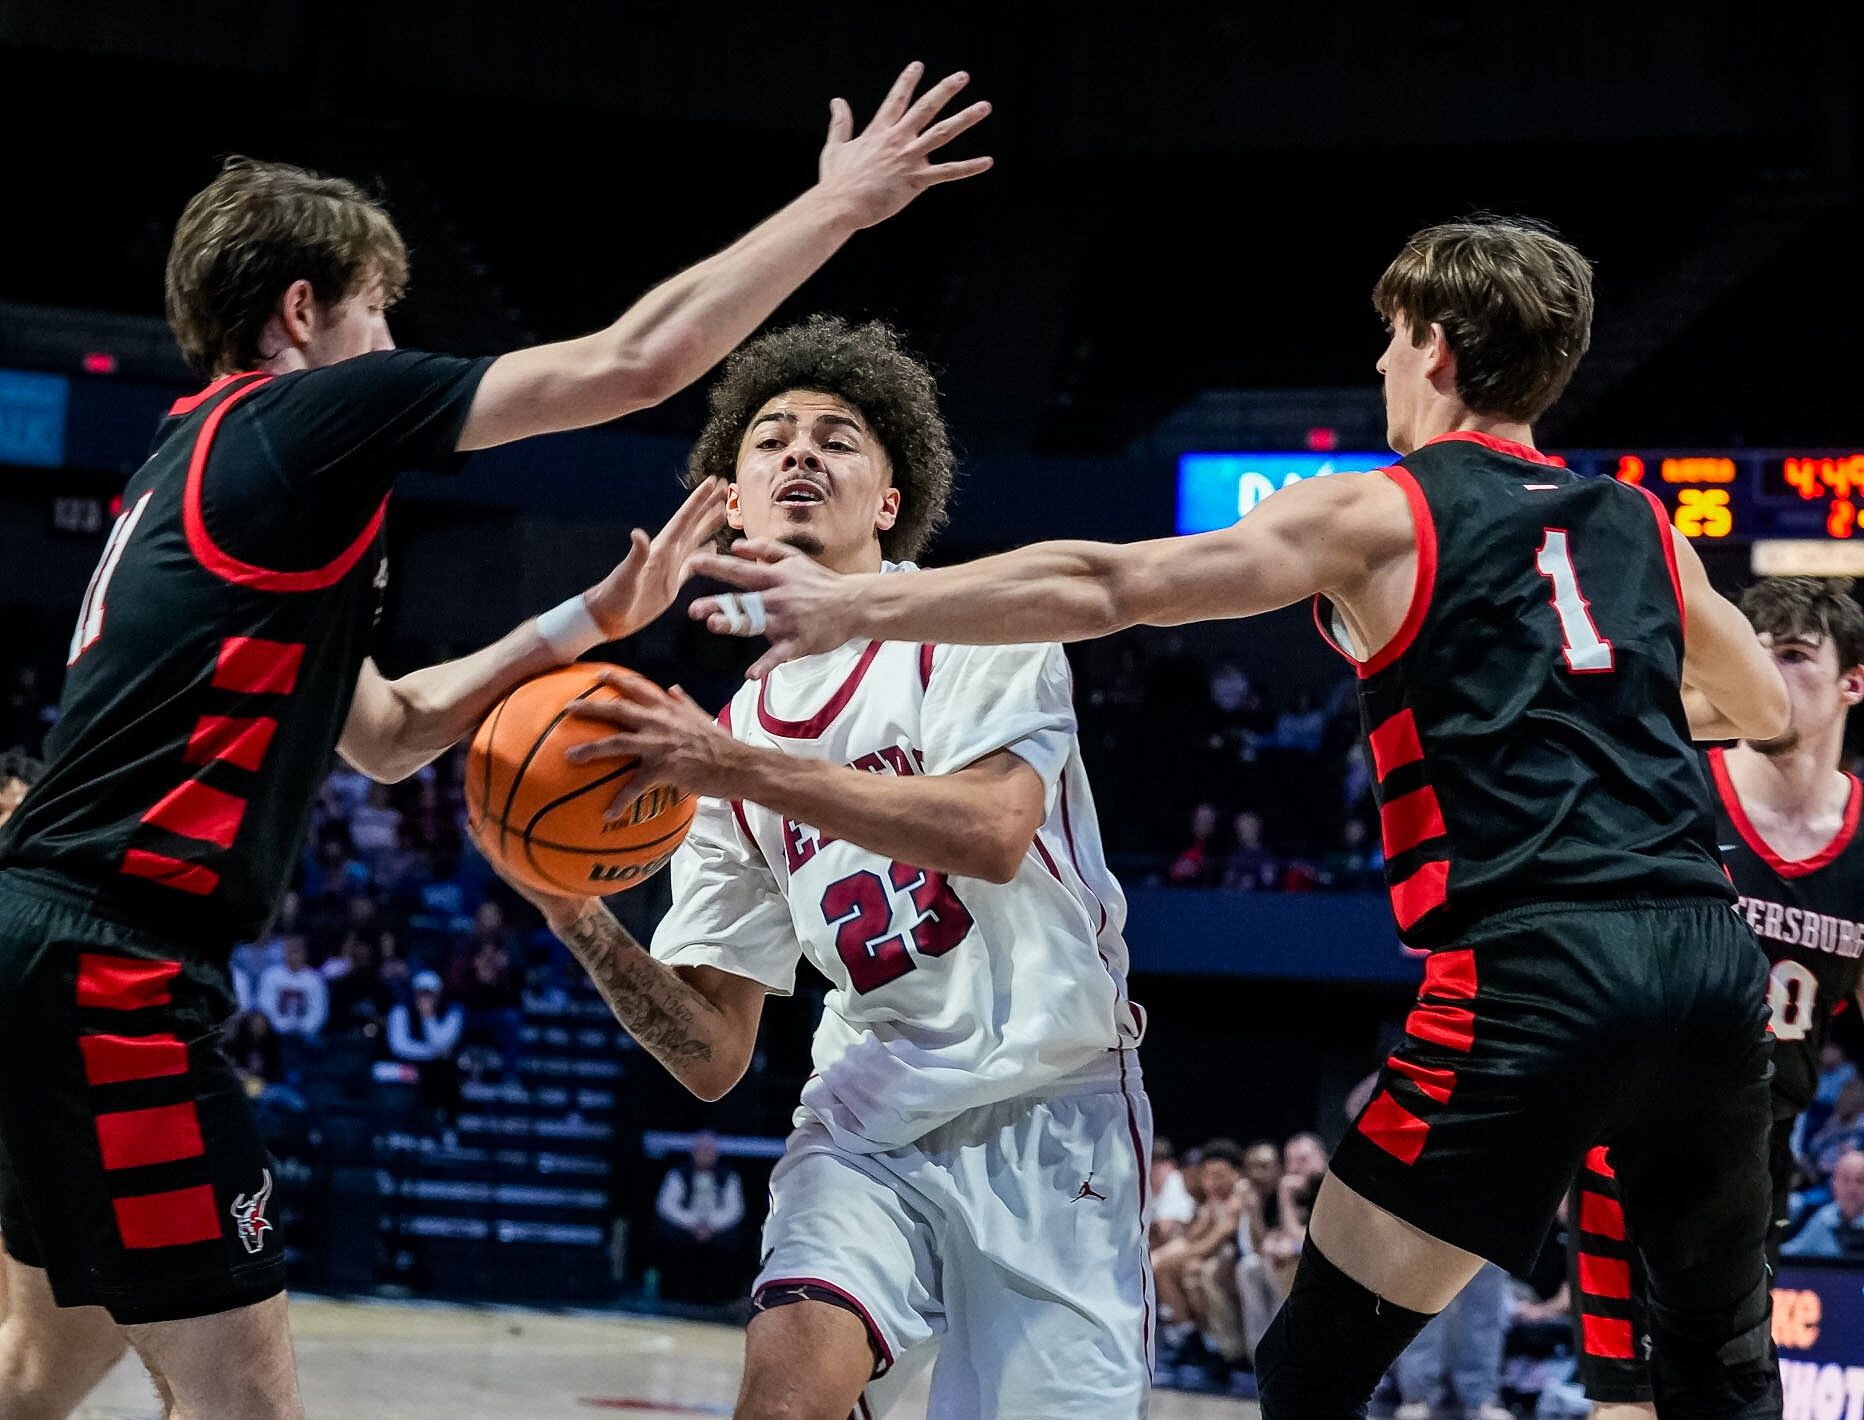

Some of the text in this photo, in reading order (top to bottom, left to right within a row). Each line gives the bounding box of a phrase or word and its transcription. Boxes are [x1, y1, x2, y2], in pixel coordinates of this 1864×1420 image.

[1674, 488, 1733, 537] 25
[1534, 526, 1615, 674] 1
[820, 858, 975, 996] 23
